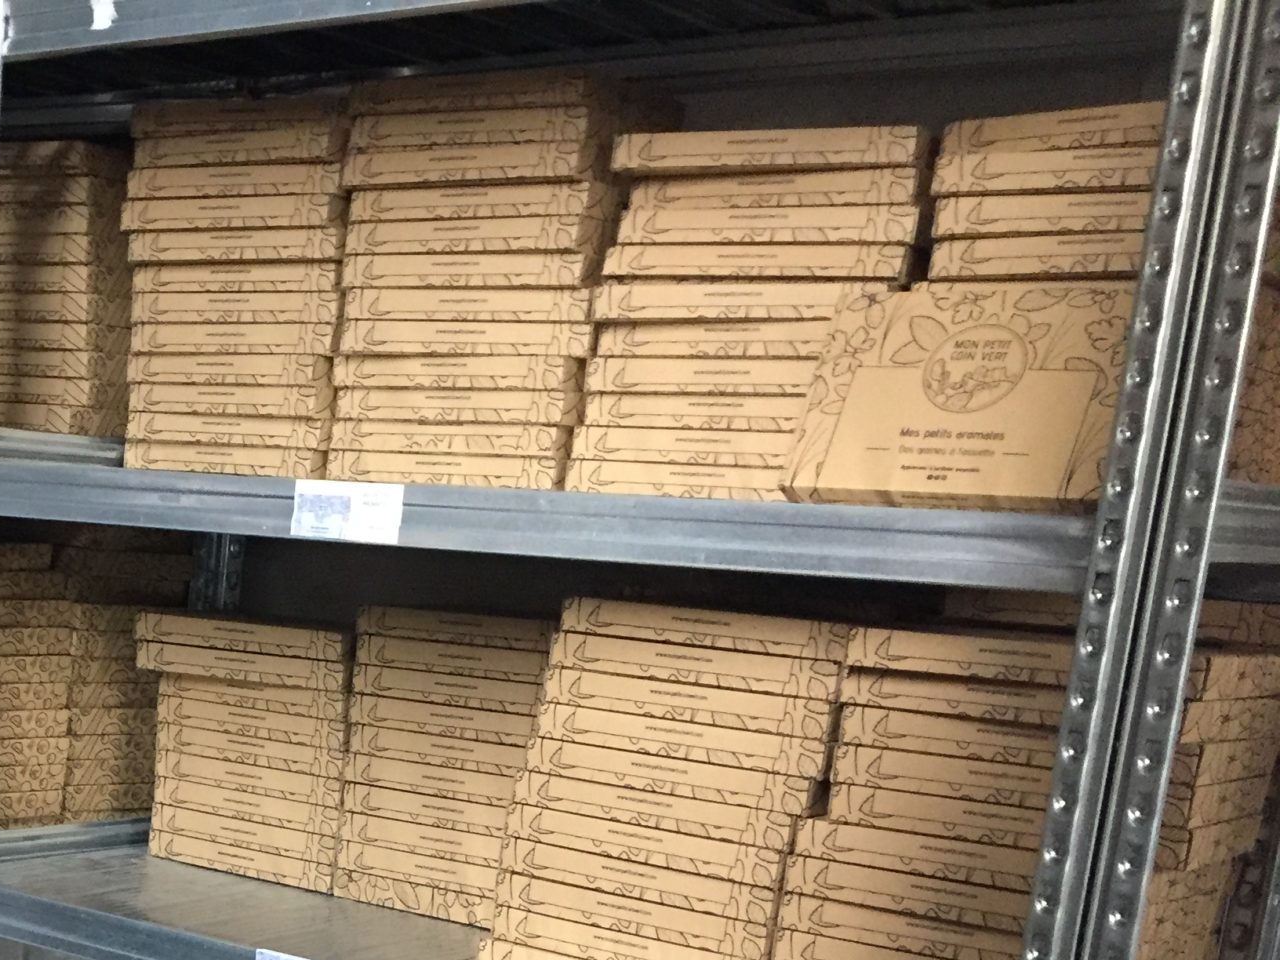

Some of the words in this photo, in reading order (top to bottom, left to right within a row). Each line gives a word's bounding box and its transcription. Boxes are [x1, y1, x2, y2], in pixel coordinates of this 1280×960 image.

[954, 340, 979, 349] MON
[983, 340, 1012, 349] PETIT
[950, 352, 975, 361] COIN
[981, 352, 1008, 362] VERT
[899, 428, 920, 438] Mes
